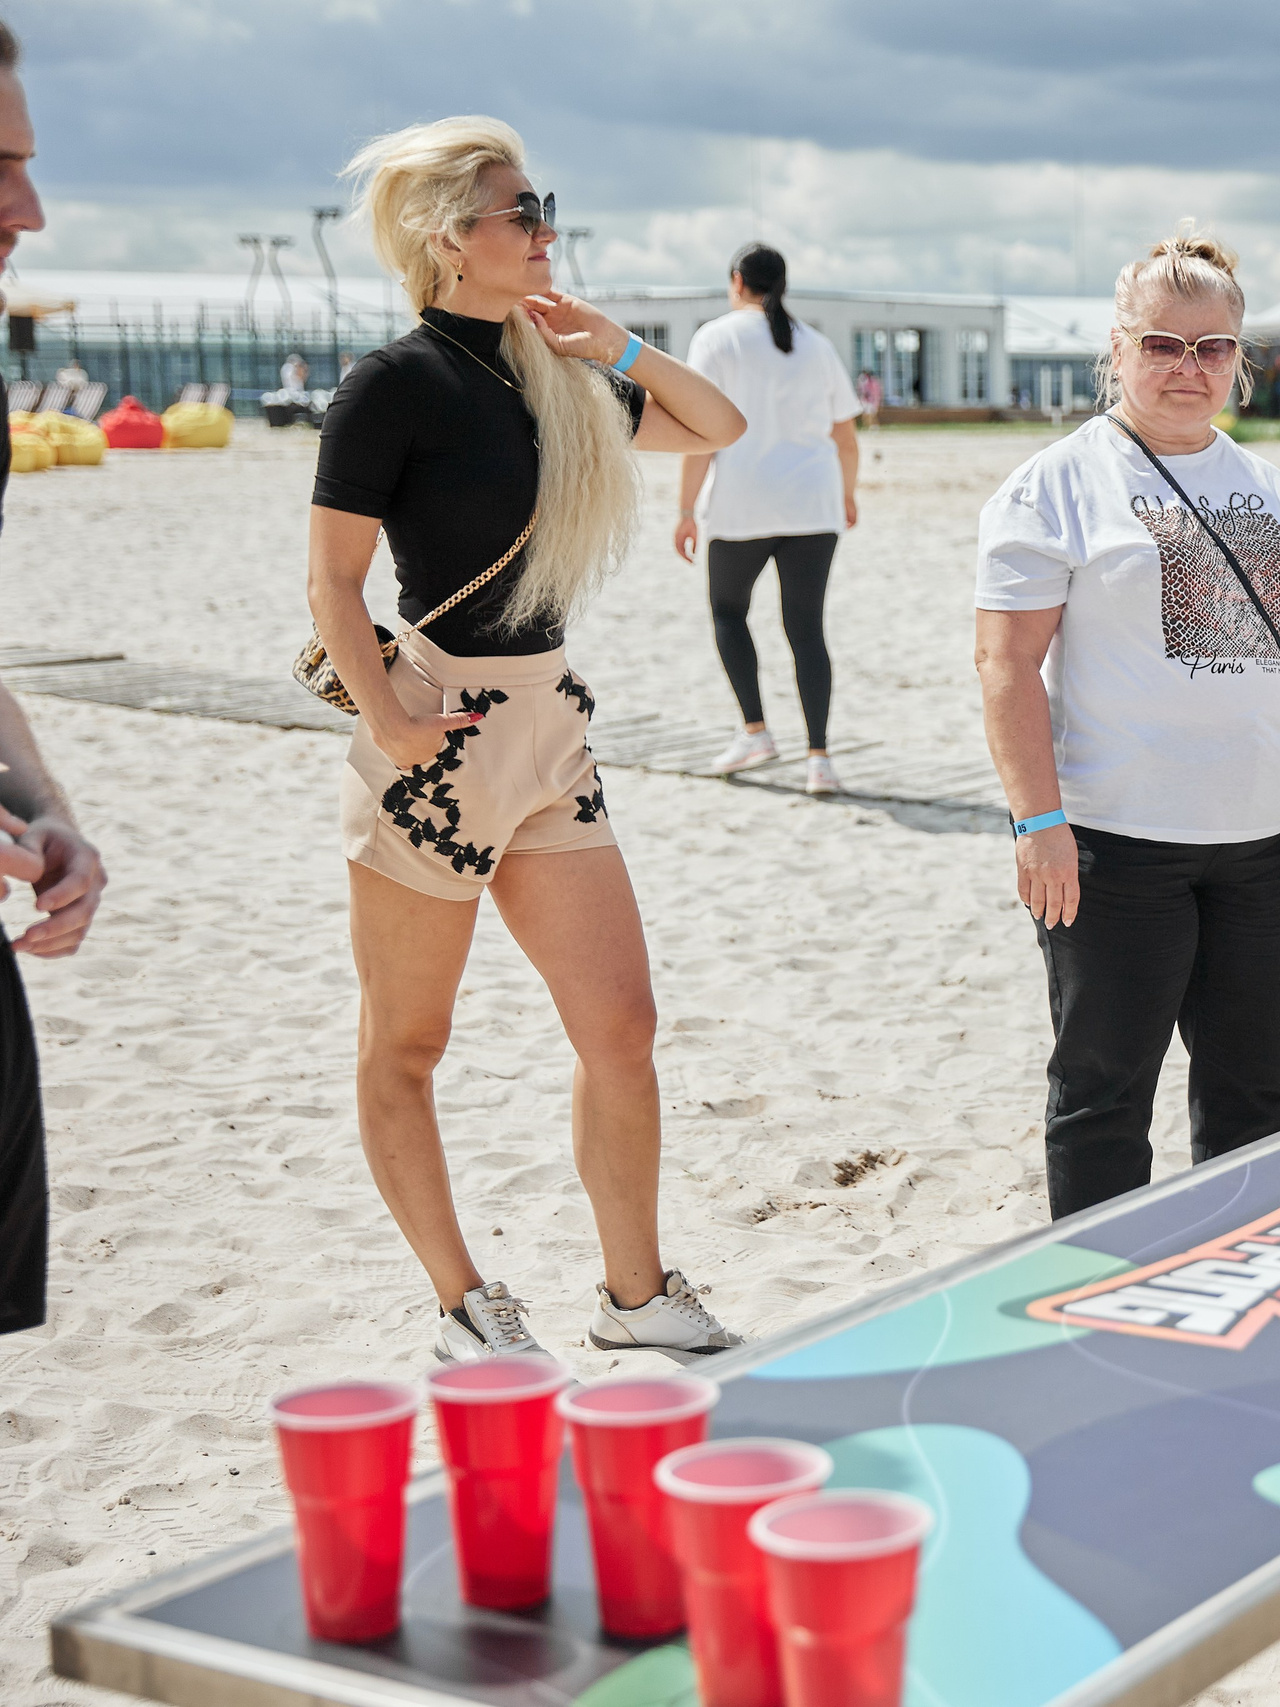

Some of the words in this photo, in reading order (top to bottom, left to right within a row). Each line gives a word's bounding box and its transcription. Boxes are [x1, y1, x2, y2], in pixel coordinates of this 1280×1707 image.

[1180, 647, 1246, 680] Paris
[1261, 666, 1277, 674] THAT
[1017, 823, 1027, 833] 05
